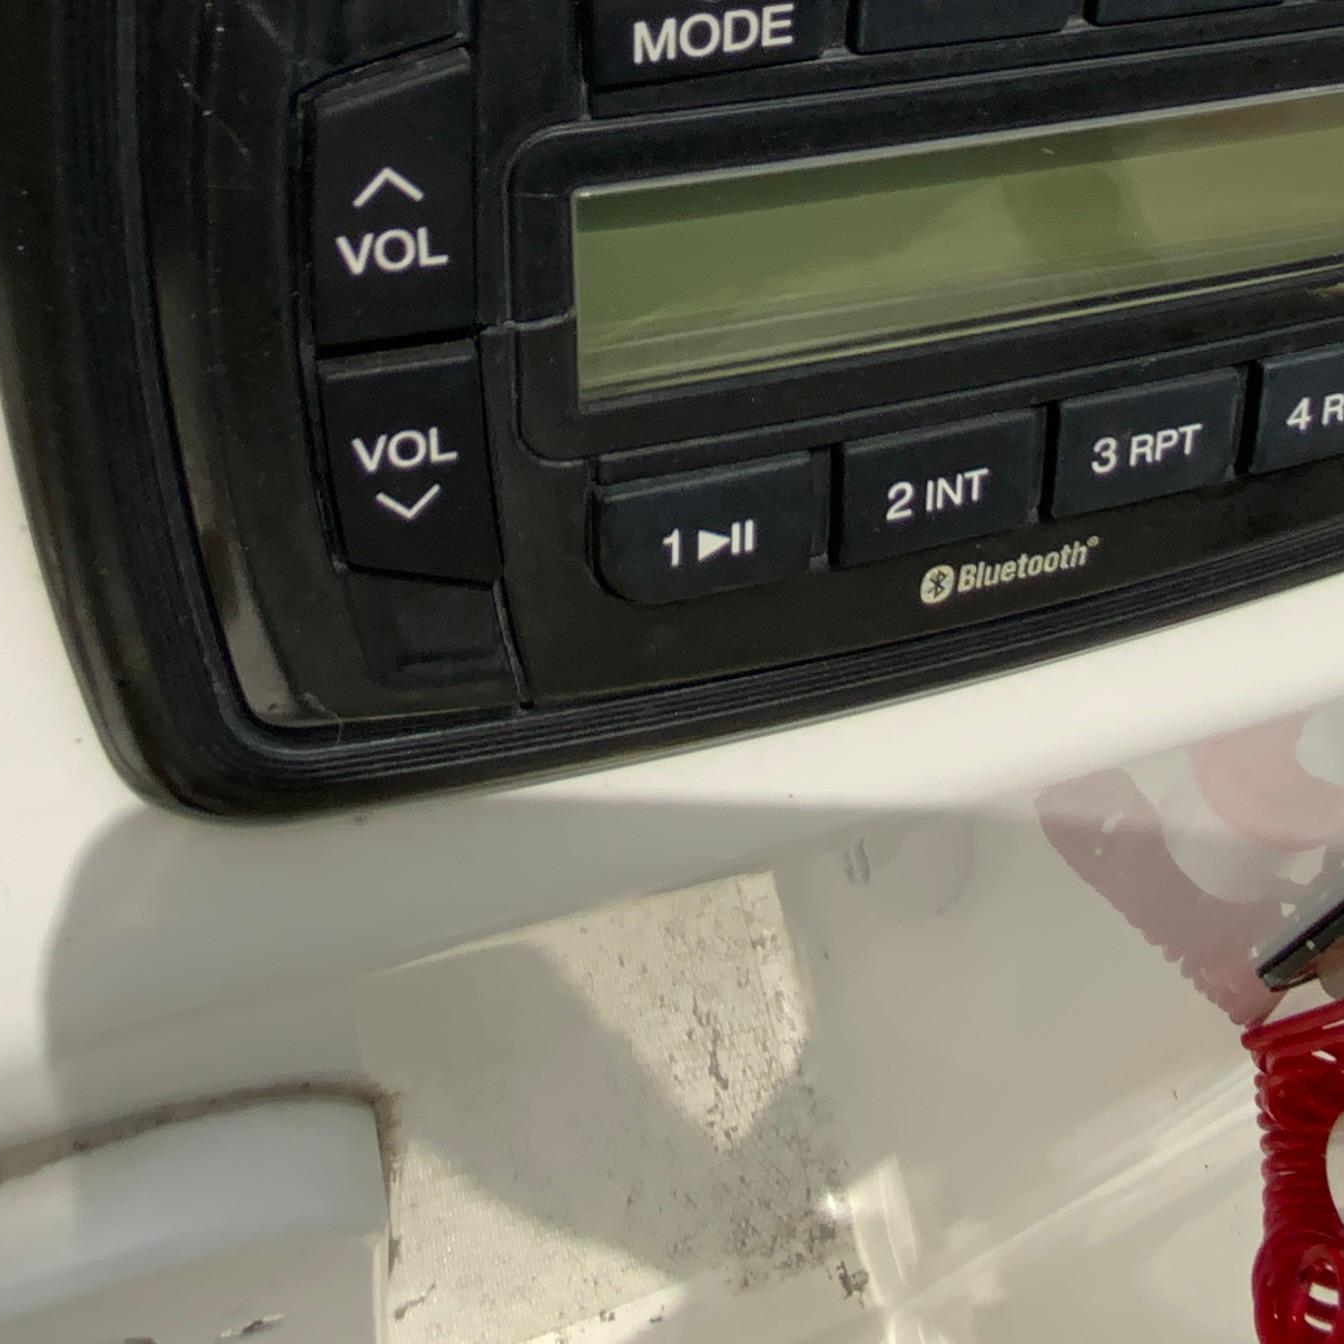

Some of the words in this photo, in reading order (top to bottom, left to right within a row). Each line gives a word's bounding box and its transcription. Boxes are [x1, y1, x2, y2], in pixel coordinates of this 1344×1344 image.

[633, 3, 793, 66] MODE
[337, 227, 449, 277] VOL
[1287, 395, 1314, 431] 4
[352, 426, 458, 474] VOL
[1092, 438, 1118, 474] 3
[1129, 423, 1202, 468] RPT
[886, 481, 914, 522] 2
[925, 468, 989, 516] INT
